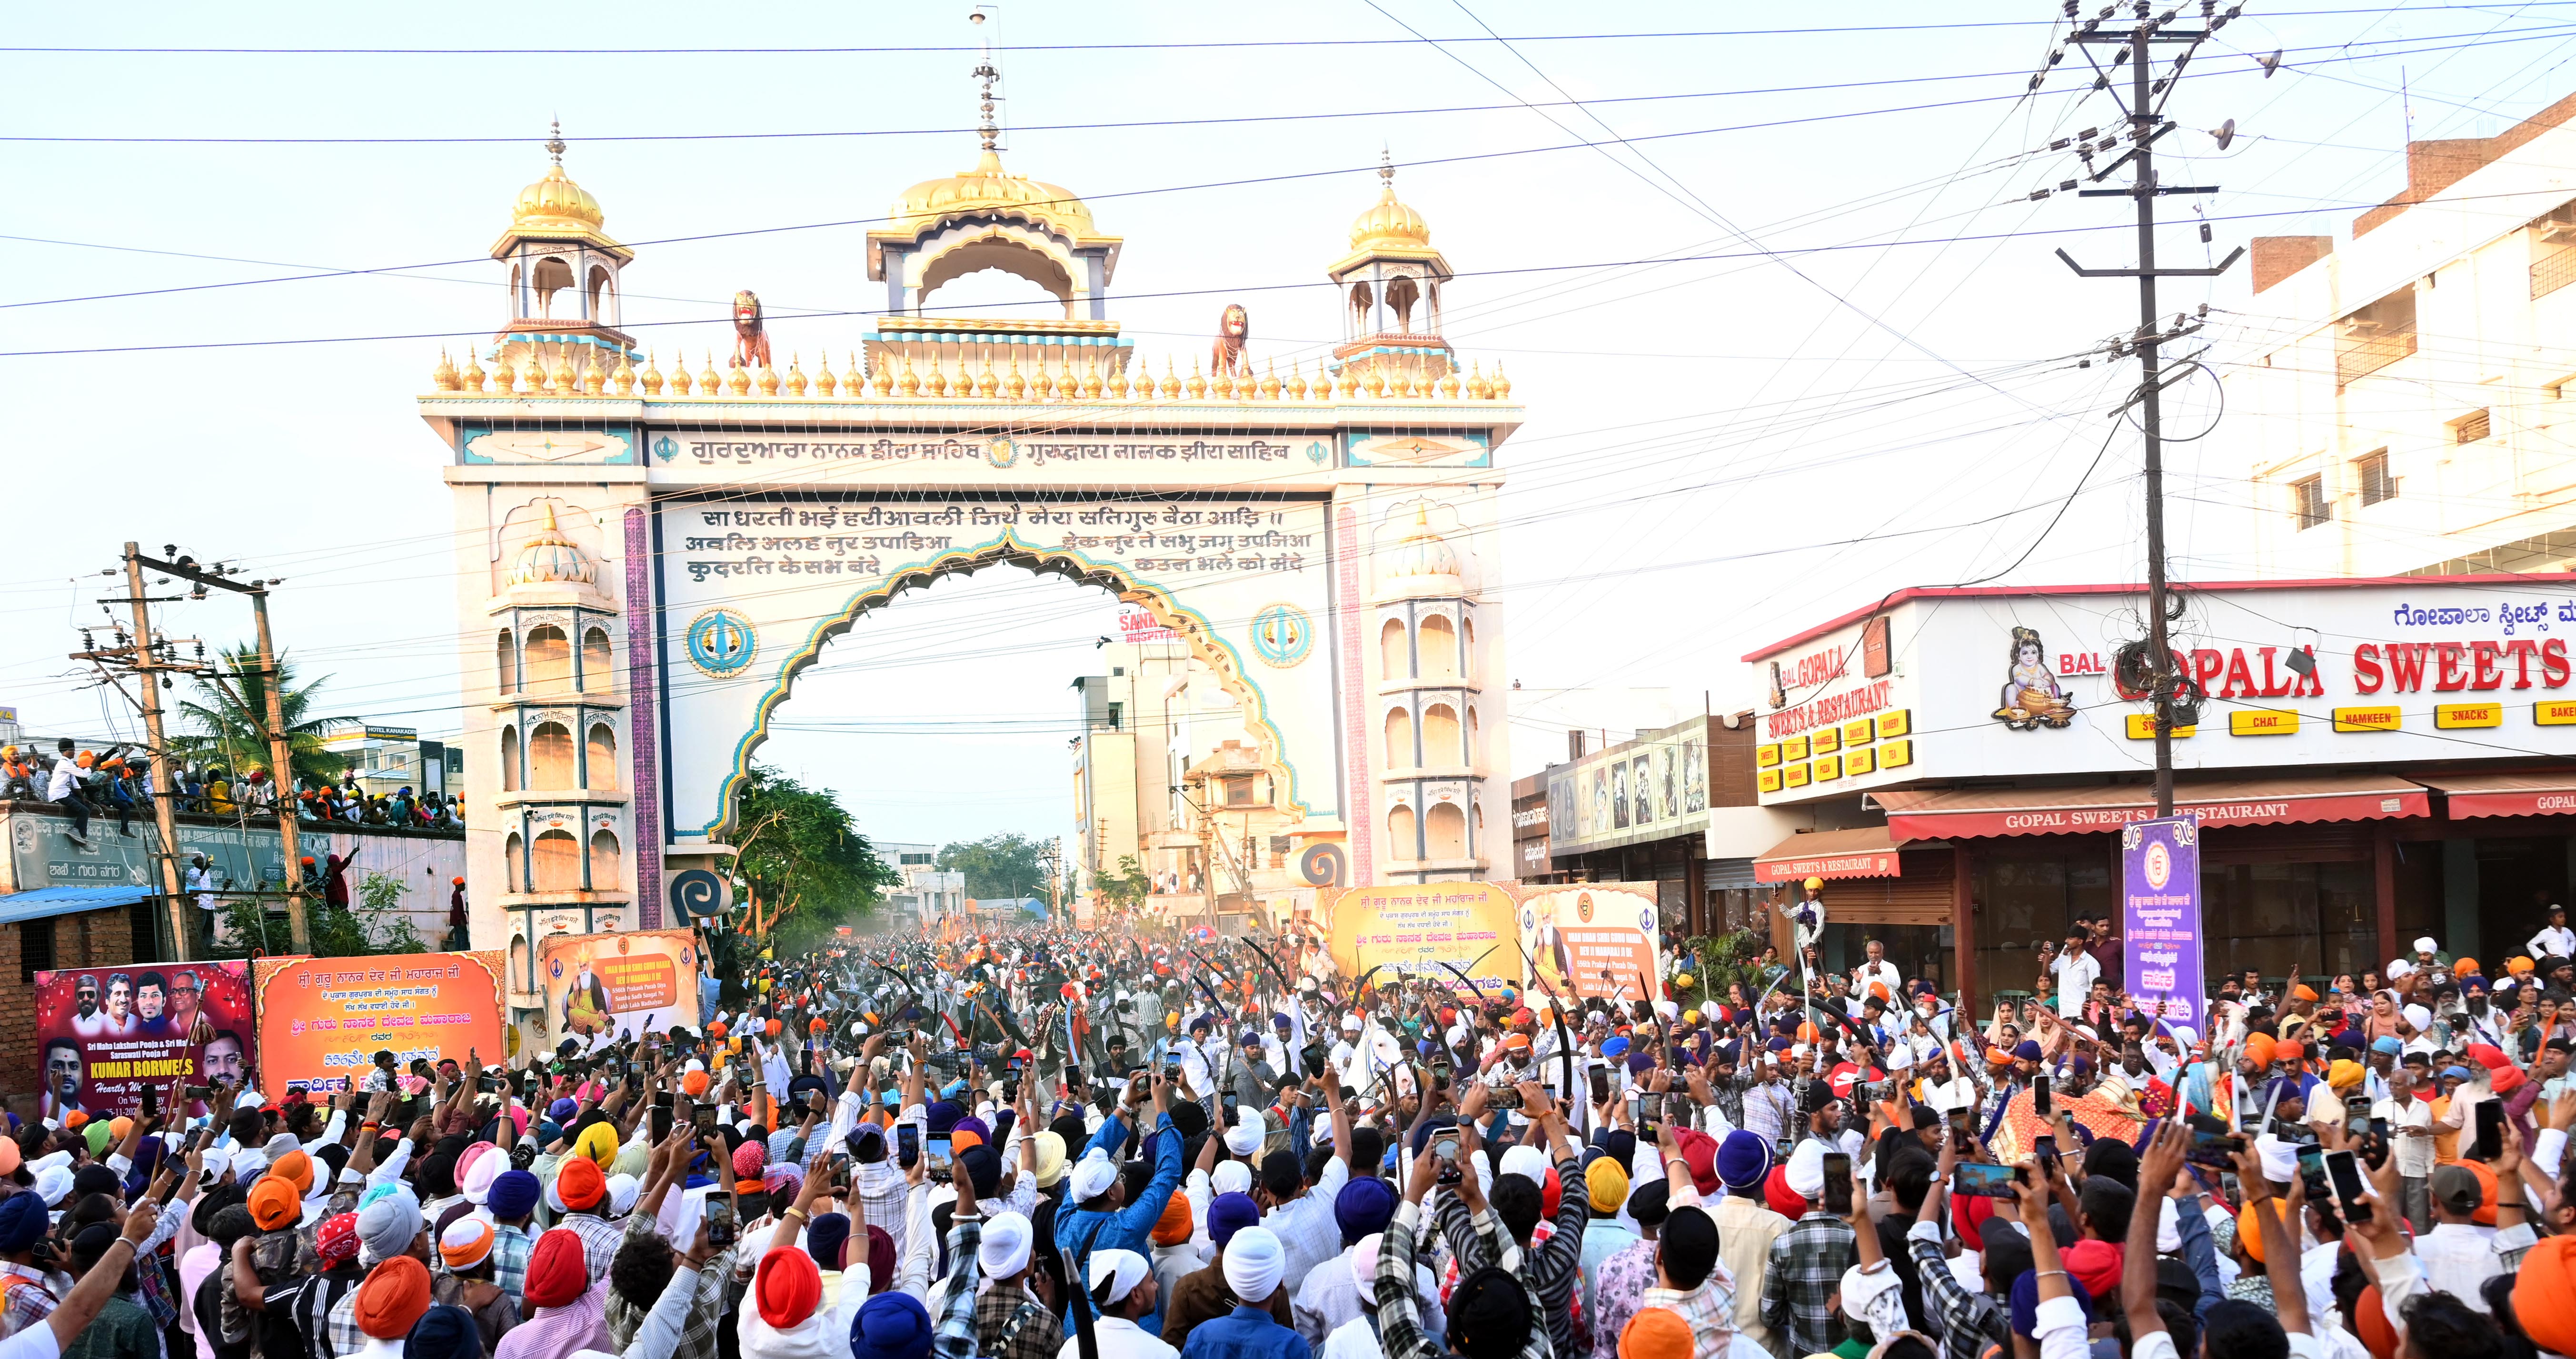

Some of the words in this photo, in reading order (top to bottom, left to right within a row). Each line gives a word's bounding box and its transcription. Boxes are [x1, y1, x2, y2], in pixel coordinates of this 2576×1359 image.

[811, 442, 866, 459] ਨਾਨਕ
[921, 439, 981, 459] ਸਾਹਿਬ
[1114, 442, 1177, 460] नानक
[1180, 441, 1224, 462] झीरा
[1228, 440, 1291, 461] साहिब
[701, 511, 730, 526] सा
[734, 507, 793, 526] धरती
[843, 506, 964, 527] हरीआवली
[1027, 505, 1072, 525] मेरा
[1162, 507, 1203, 526] बैठा
[686, 532, 756, 551] अवलि
[763, 536, 821, 551] अलह
[1139, 532, 1154, 548] ते
[1160, 535, 1196, 555] सभु
[687, 556, 775, 583] कुदरति
[778, 554, 801, 575] के
[804, 560, 843, 575] सभ
[1197, 553, 1232, 572] भले
[1237, 552, 1265, 572] को
[2394, 603, 2490, 626] ಗೋಪಾಲಾ
[1782, 668, 1796, 688] BAL
[1798, 645, 1846, 688] GOPALA
[2059, 652, 2107, 675] BAL
[2114, 645, 2325, 702] PALA
[2354, 638, 2571, 694] SWEETS
[1769, 706, 1805, 738] SWEETS
[1817, 680, 1890, 725] RESTAURANT
[2452, 710, 2488, 721] SNACKS
[1882, 717, 1900, 731] BAKERY
[2253, 717, 2278, 727] CHAT
[2346, 713, 2391, 724] NAMKEEN
[1849, 726, 1865, 739] SNACKS
[1789, 742, 1800, 754] CHAT
[1760, 749, 1774, 761] SWEETS
[1851, 755, 1864, 768] JUICE
[1888, 749, 1898, 761] TEA
[1820, 763, 1830, 774] PIZZA
[1763, 775, 1774, 786] TIFFIN
[1788, 770, 1802, 782] BURGER
[2537, 795, 2576, 809] GOPAL
[2006, 813, 2066, 828] GOPAL
[2174, 803, 2289, 820] RESTAURANT
[193, 830, 214, 843] CENTRAL
[215, 831, 228, 843] BANK
[78, 864, 97, 877] ಗುರು
[100, 865, 120, 877] ನಗರ
[1771, 863, 1792, 876] GOPAL
[1821, 861, 1827, 872] &
[1828, 857, 1871, 872] RESTAURANT
[1373, 897, 1387, 910] ਗੁਰੂ
[1391, 897, 1412, 905] ਨਾਨਕ
[1416, 894, 1429, 905] ਦੇਵ
[1432, 893, 1442, 904] ਜੀ
[1445, 894, 1475, 904] ਮਹਾਰਾਜ
[1478, 891, 1487, 902] ਜੀ
[1356, 934, 1367, 947] ಶ್ರೀ
[1372, 933, 1391, 944] ಗುರು
[1396, 932, 1422, 943] ನಾನಕ
[1456, 930, 1496, 941] ಮಹಾರಾಜ
[1567, 932, 1581, 942] DHAN
[1582, 932, 1596, 942] DHAN
[1611, 933, 1625, 943] GURU
[1579, 946, 1590, 956] DEV
[1590, 946, 1595, 956] JI
[1595, 946, 1620, 957] MAHARAJ
[1621, 947, 1625, 957] JI
[1626, 947, 1633, 957] DE
[605, 966, 618, 975] DHAN
[632, 963, 643, 972] SHRI
[643, 962, 656, 971] GURU
[1612, 961, 1627, 969] Purab
[1627, 962, 1638, 972] Diya
[315, 973, 332, 988] ਗੁਰੂ
[337, 972, 365, 983] ਨਾਨਕ
[369, 968, 385, 982] ਦੇਵ
[390, 966, 401, 981] ਜੀ
[406, 968, 444, 980] ਮਹਾਰਾਜ
[448, 964, 460, 978] ਜੀ
[616, 976, 626, 985] DEV
[630, 973, 651, 983] MAHARAJ
[651, 972, 656, 981] JI
[656, 972, 662, 981] DE
[322, 991, 328, 1000] ਦੇ
[375, 989, 382, 997] ਦੀ
[415, 986, 429, 995] ਸੰਗਤ
[627, 984, 644, 992] Prakash
[1582, 982, 1594, 991] Lakh
[402, 1000, 409, 1009] ਜੀ
[291, 1019, 305, 1035] ಶ್ರೀ
[311, 1019, 337, 1031] ಗುರು
[343, 1016, 376, 1029] ನಾನಕ
[420, 1013, 471, 1027] ಮಹಾರಾಜ
[87, 1042, 96, 1051] Sri
[96, 1042, 113, 1051] Maha
[113, 1041, 139, 1050] Lakshmi
[139, 1040, 159, 1049] Pooja
[165, 1040, 175, 1048] Sri
[110, 1050, 141, 1060] Saraswati
[141, 1050, 161, 1059] Pooja
[162, 1049, 169, 1057] of
[90, 1061, 131, 1079] KUMAR
[95, 1081, 127, 1095] Heartly
[118, 1096, 129, 1105] On
